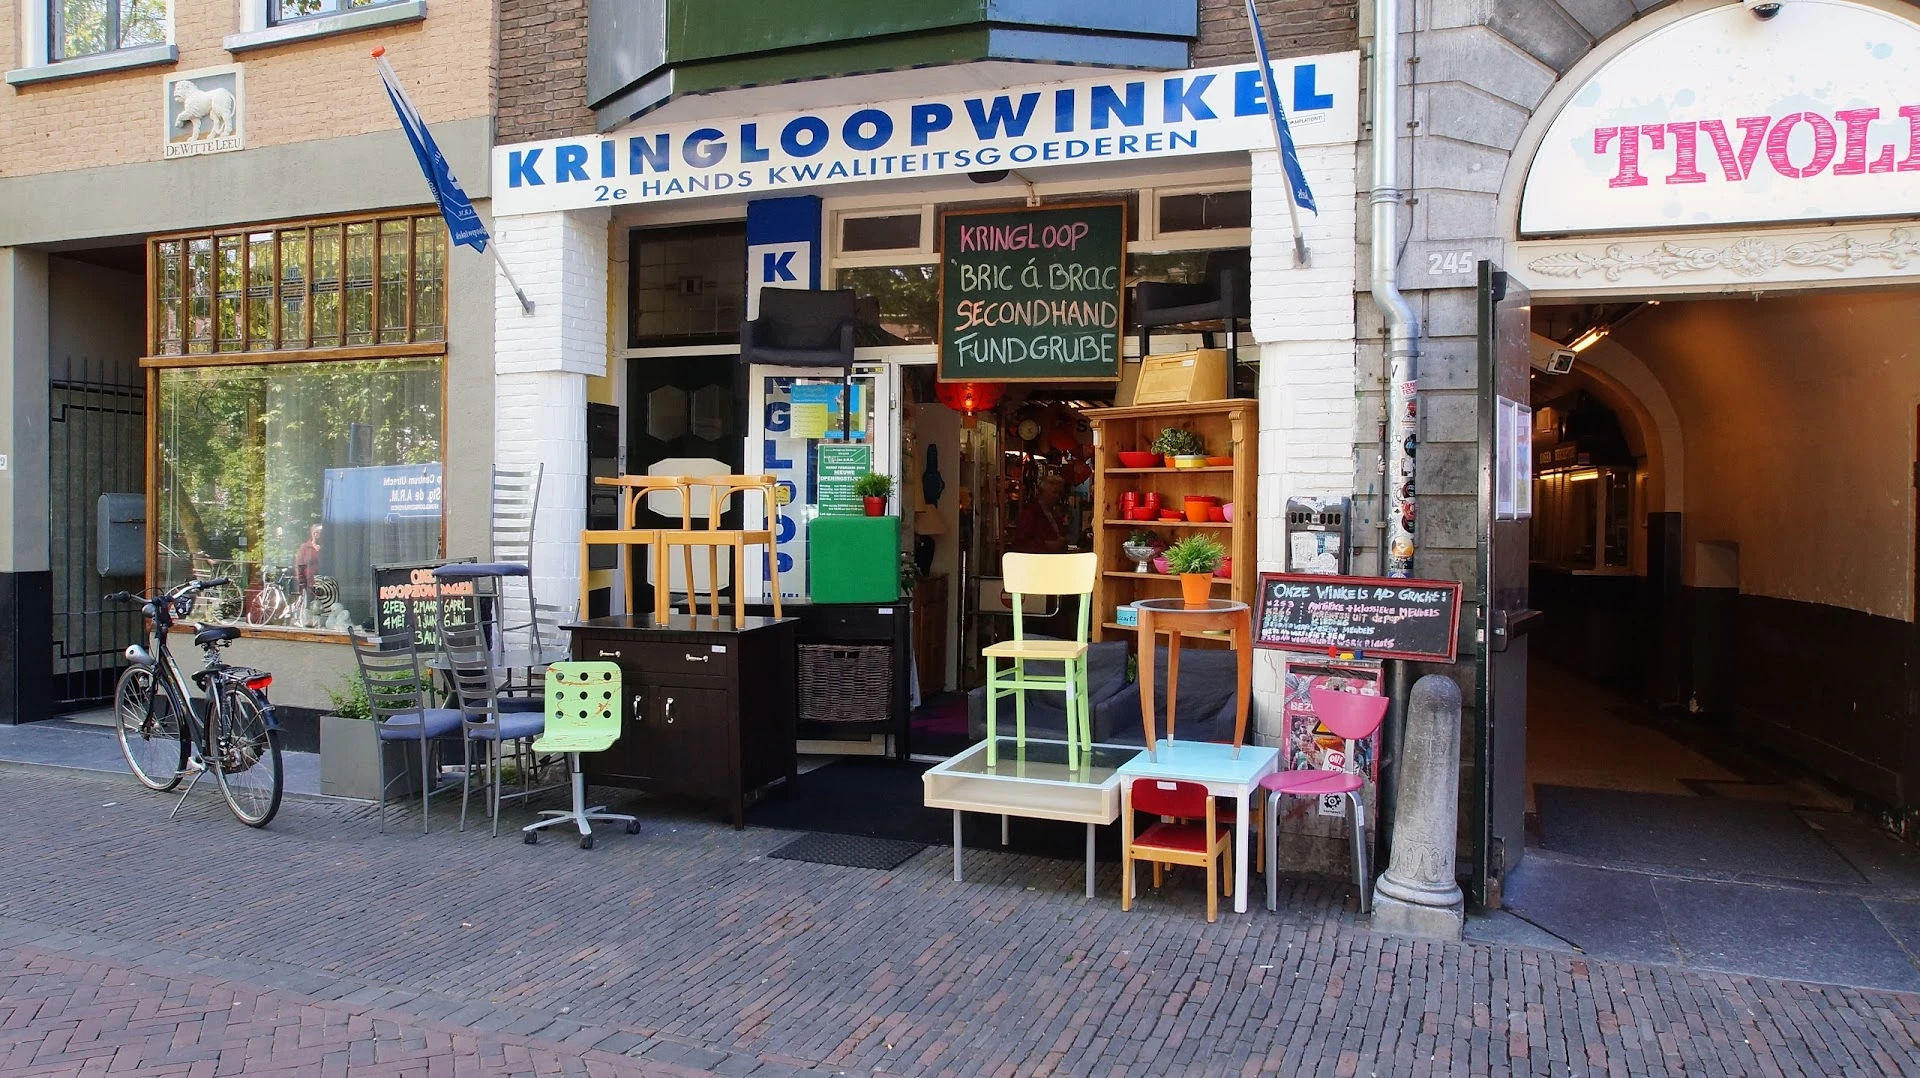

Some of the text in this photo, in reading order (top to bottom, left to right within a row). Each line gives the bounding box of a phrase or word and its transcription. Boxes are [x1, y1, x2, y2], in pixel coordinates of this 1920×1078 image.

[508, 63, 1334, 189] KRINGLOOPWINKEL
[166, 138, 241, 157] DE WITTE LEEU
[594, 129, 1197, 202] 2e HANDS KWALITEITSGOEDEREN
[960, 222, 1089, 253] KRINGLOOP
[1428, 251, 1473, 275] 245
[954, 299, 1119, 331] SECONDHAND
[954, 332, 1116, 367] FUNDGRUBE
[380, 580, 473, 600] KOOPZONAGEN
[1273, 583, 1311, 599] ONZE
